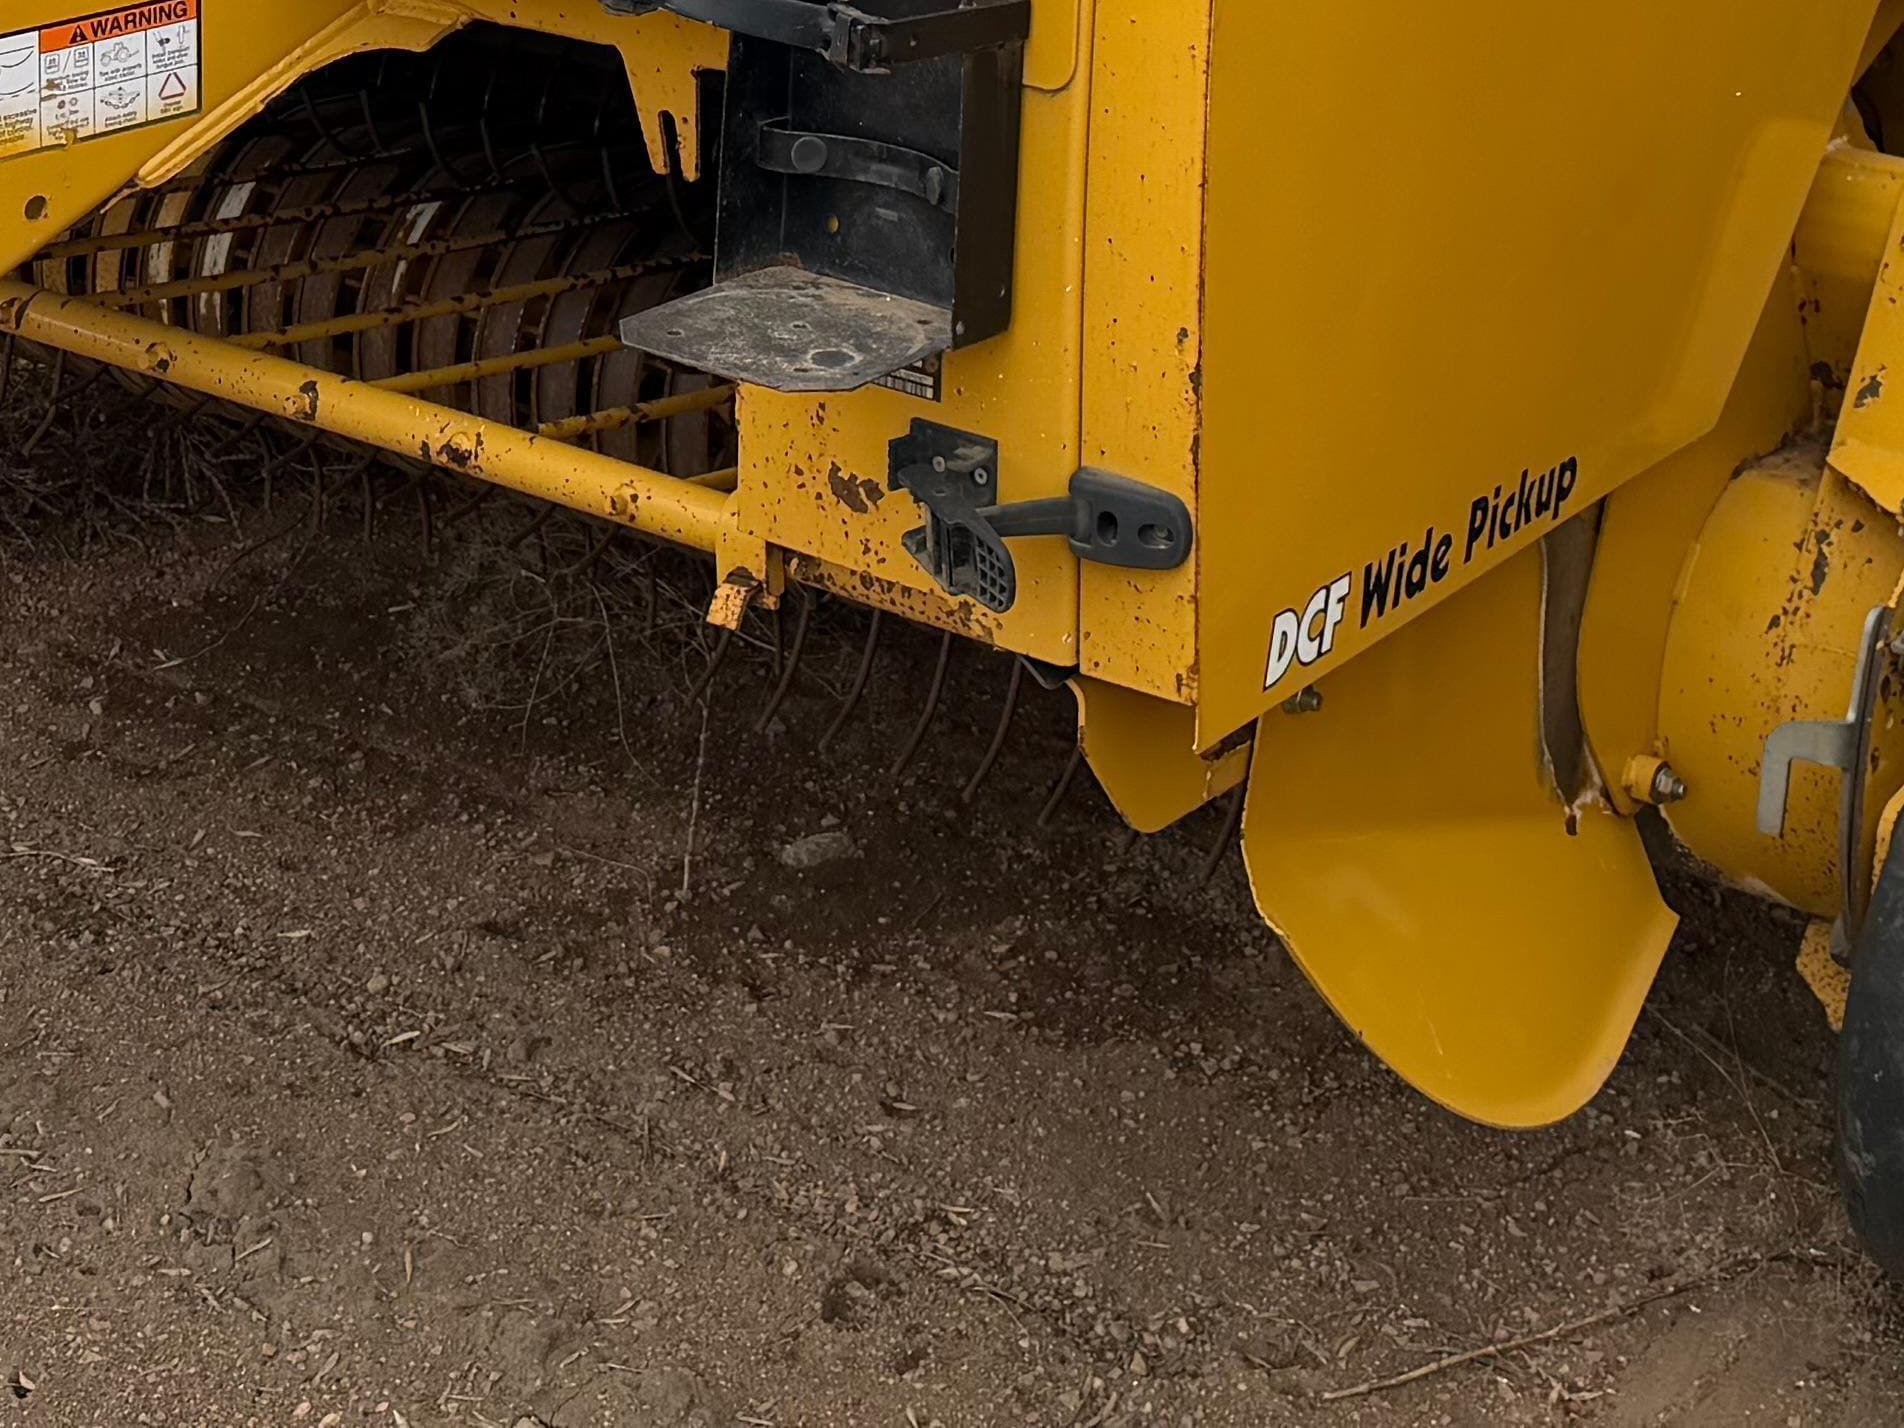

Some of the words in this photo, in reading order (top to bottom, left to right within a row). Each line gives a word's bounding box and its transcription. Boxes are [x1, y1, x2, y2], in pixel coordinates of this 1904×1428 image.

[90, 0, 188, 38] WARNING
[1262, 571, 1353, 692] DCF
[1360, 526, 1453, 630] Wide
[1463, 455, 1578, 565] Pickup
